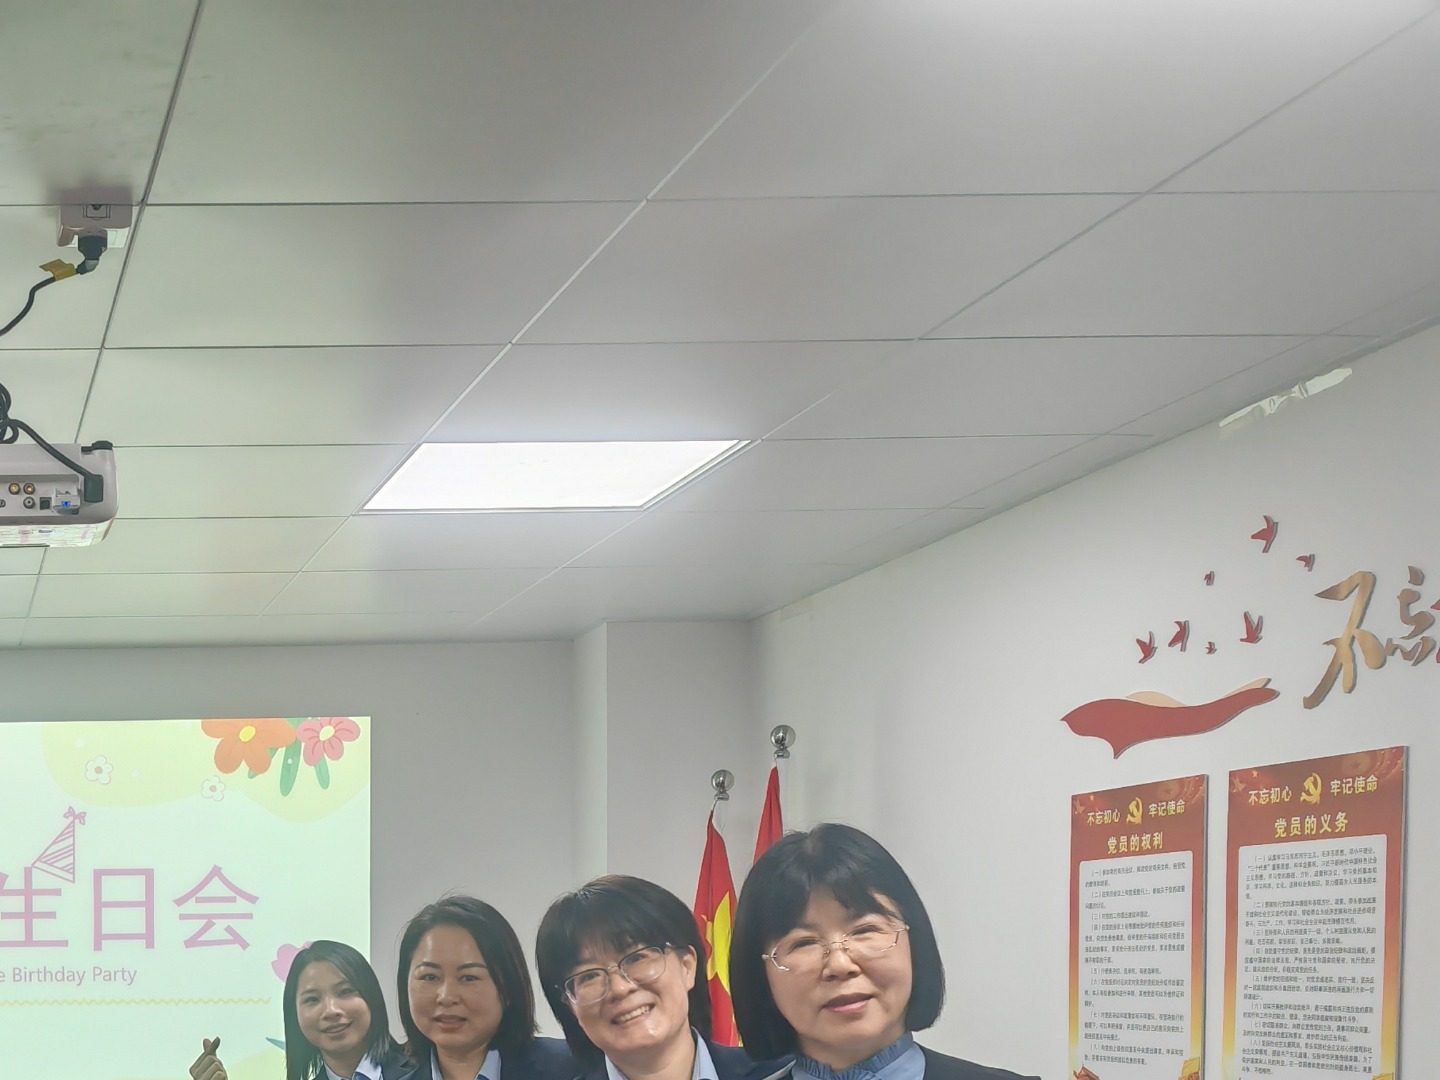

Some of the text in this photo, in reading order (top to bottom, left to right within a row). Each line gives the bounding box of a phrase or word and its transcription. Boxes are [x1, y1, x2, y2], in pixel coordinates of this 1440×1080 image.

[1248, 774, 1378, 806] 不忘初心 牢记使命
[1087, 799, 1185, 827] 不忘初心 牢记使命
[1274, 811, 1348, 838] 党员的义务
[1107, 832, 1163, 854] 党员的权利
[12, 966, 86, 987] Birthday
[92, 966, 138, 986] Party
